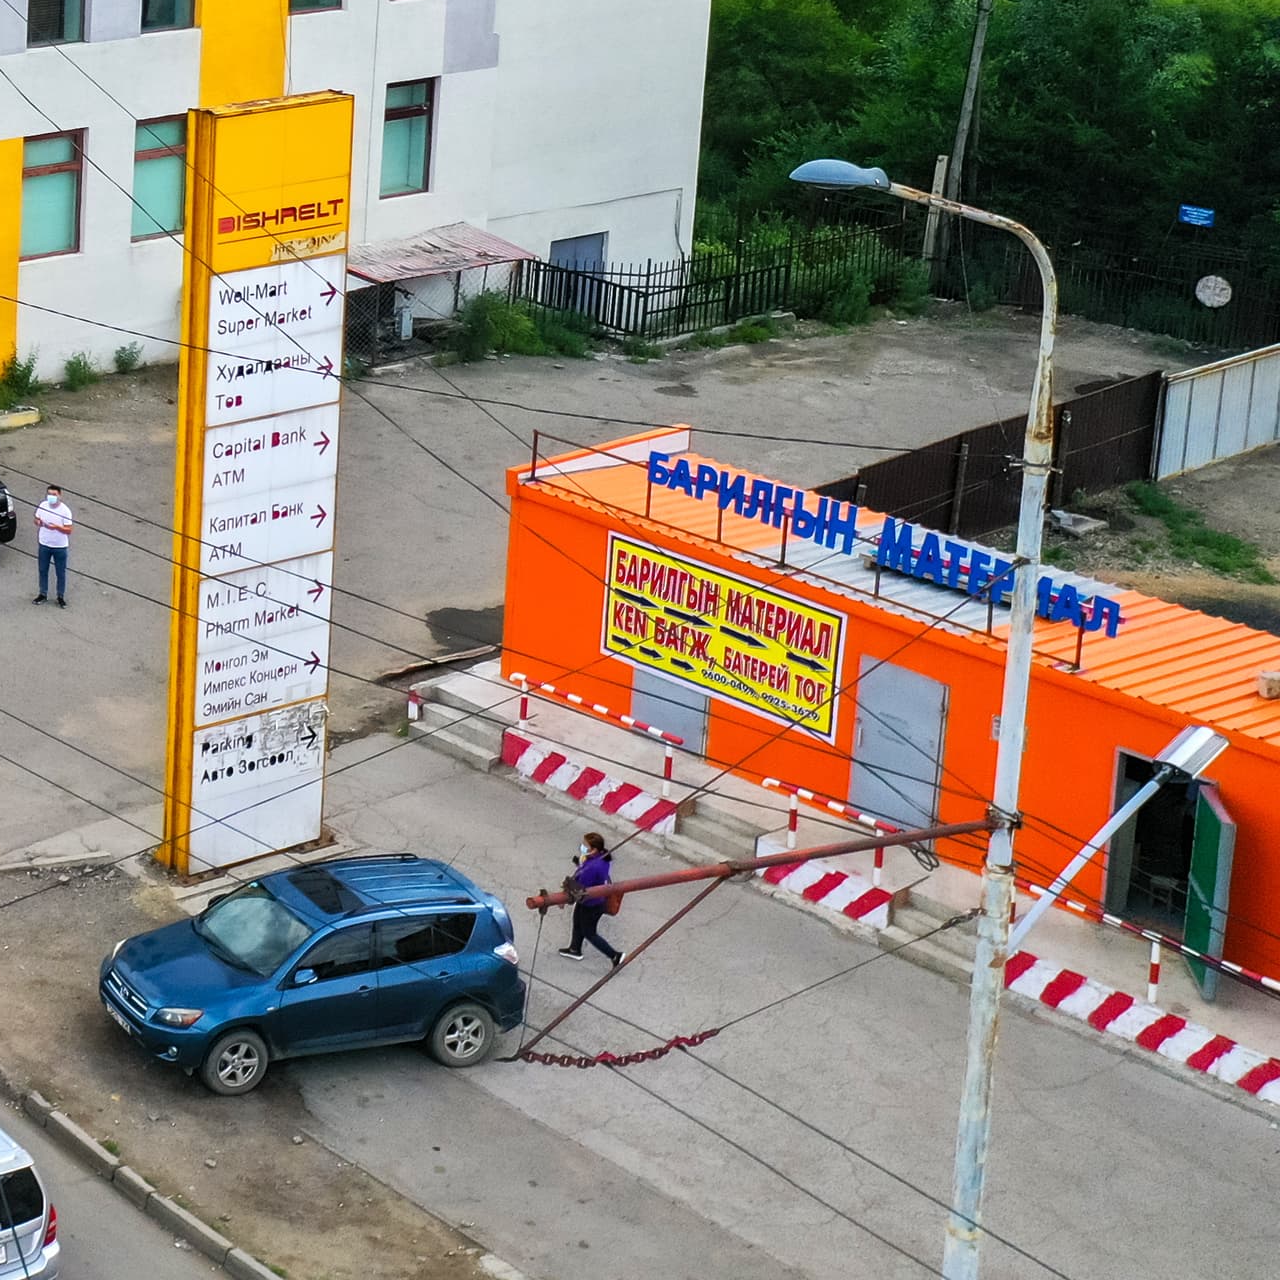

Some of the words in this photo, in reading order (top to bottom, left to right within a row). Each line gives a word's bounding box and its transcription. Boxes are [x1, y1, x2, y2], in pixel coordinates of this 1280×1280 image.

[219, 281, 287, 306] Well-Mart
[217, 317, 260, 336] Super
[265, 305, 312, 327] Market
[216, 352, 311, 383] Худалдааны
[212, 434, 266, 459] Capital
[271, 426, 307, 448] Bank
[212, 468, 245, 488] ATM
[209, 510, 267, 534] Капитал
[271, 502, 304, 520] Банк
[648, 450, 858, 556] БАРИЛГЫН
[614, 549, 721, 618] БАРИЛГЫН
[725, 588, 833, 660] МАТЕРИАЛ
[205, 616, 250, 639] Pharm
[254, 603, 300, 626] Market
[204, 654, 248, 676] Монгол
[251, 649, 269, 663] Эм
[722, 646, 791, 694] БАТЕРЕЙ
[795, 675, 827, 706] ТОГ
[203, 674, 246, 696] Импекс
[249, 663, 298, 686] Концерн
[203, 696, 241, 717] Эмийн
[244, 691, 268, 706] Сан
[201, 733, 254, 758] Parking
[201, 766, 234, 785] Авто
[239, 750, 294, 775] Зогсоол
